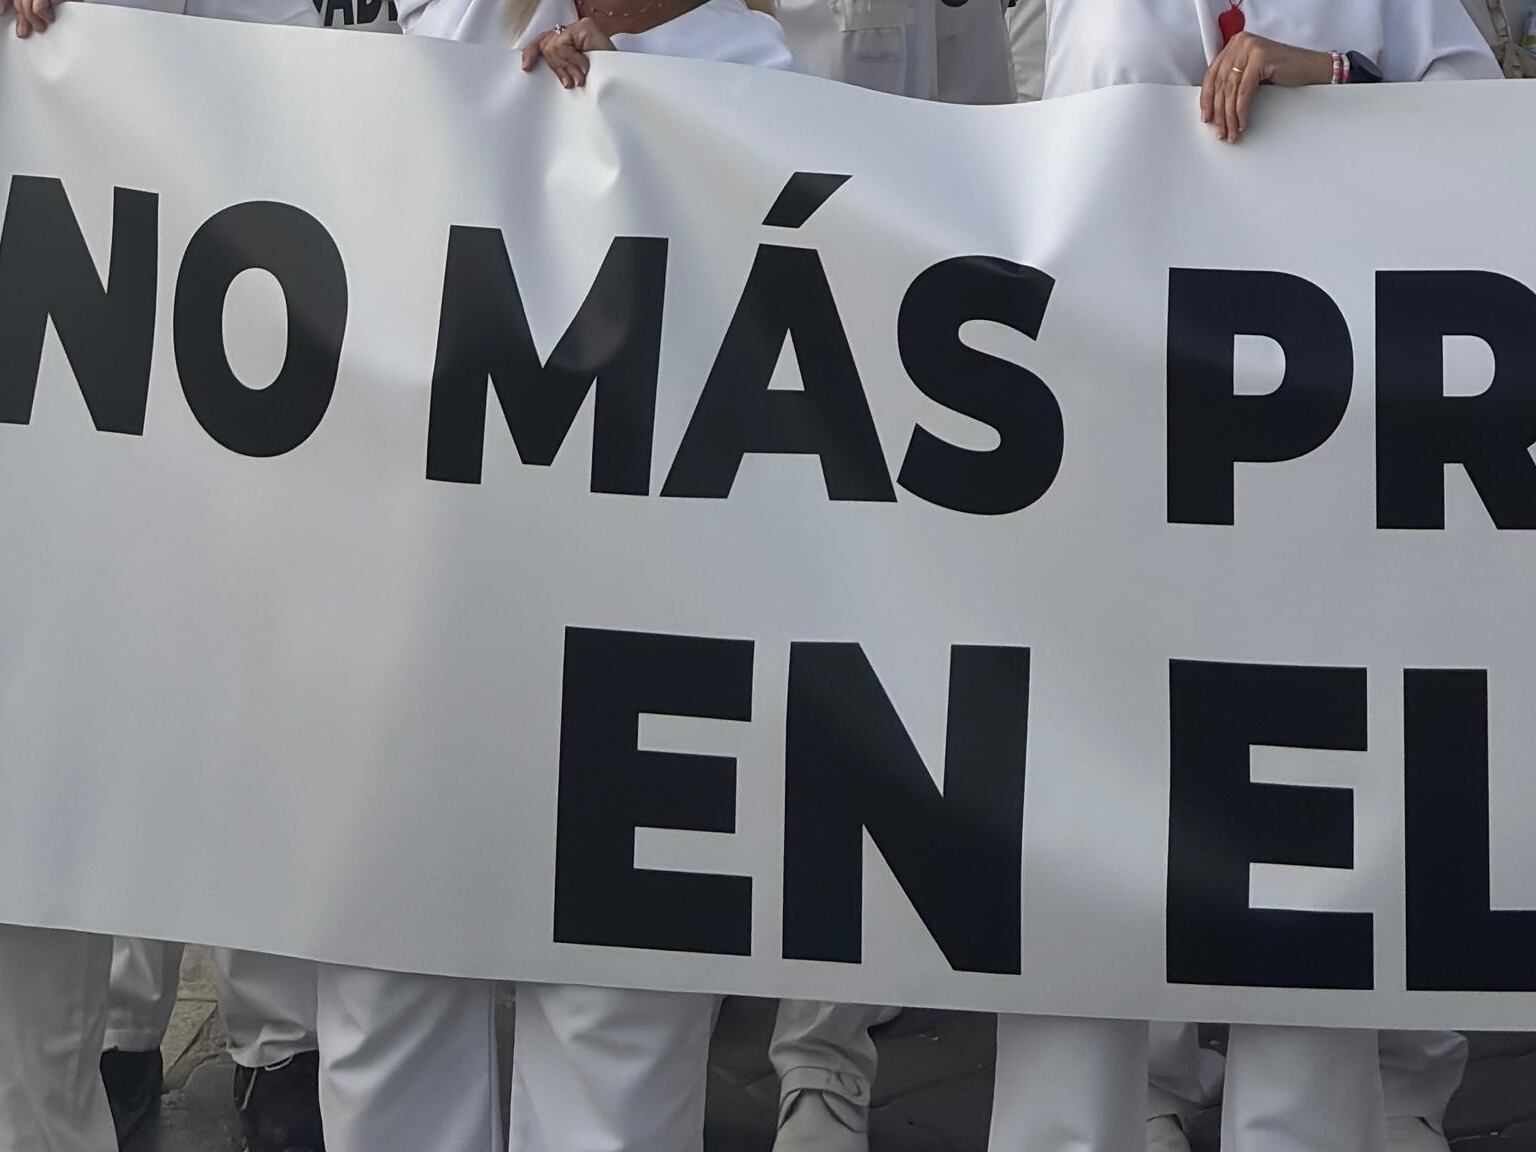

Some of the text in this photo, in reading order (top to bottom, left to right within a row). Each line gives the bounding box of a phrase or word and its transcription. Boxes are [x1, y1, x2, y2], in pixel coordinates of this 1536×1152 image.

[0, 174, 349, 458] NO
[425, 171, 1065, 516] MÁS
[552, 625, 1031, 976] EN
